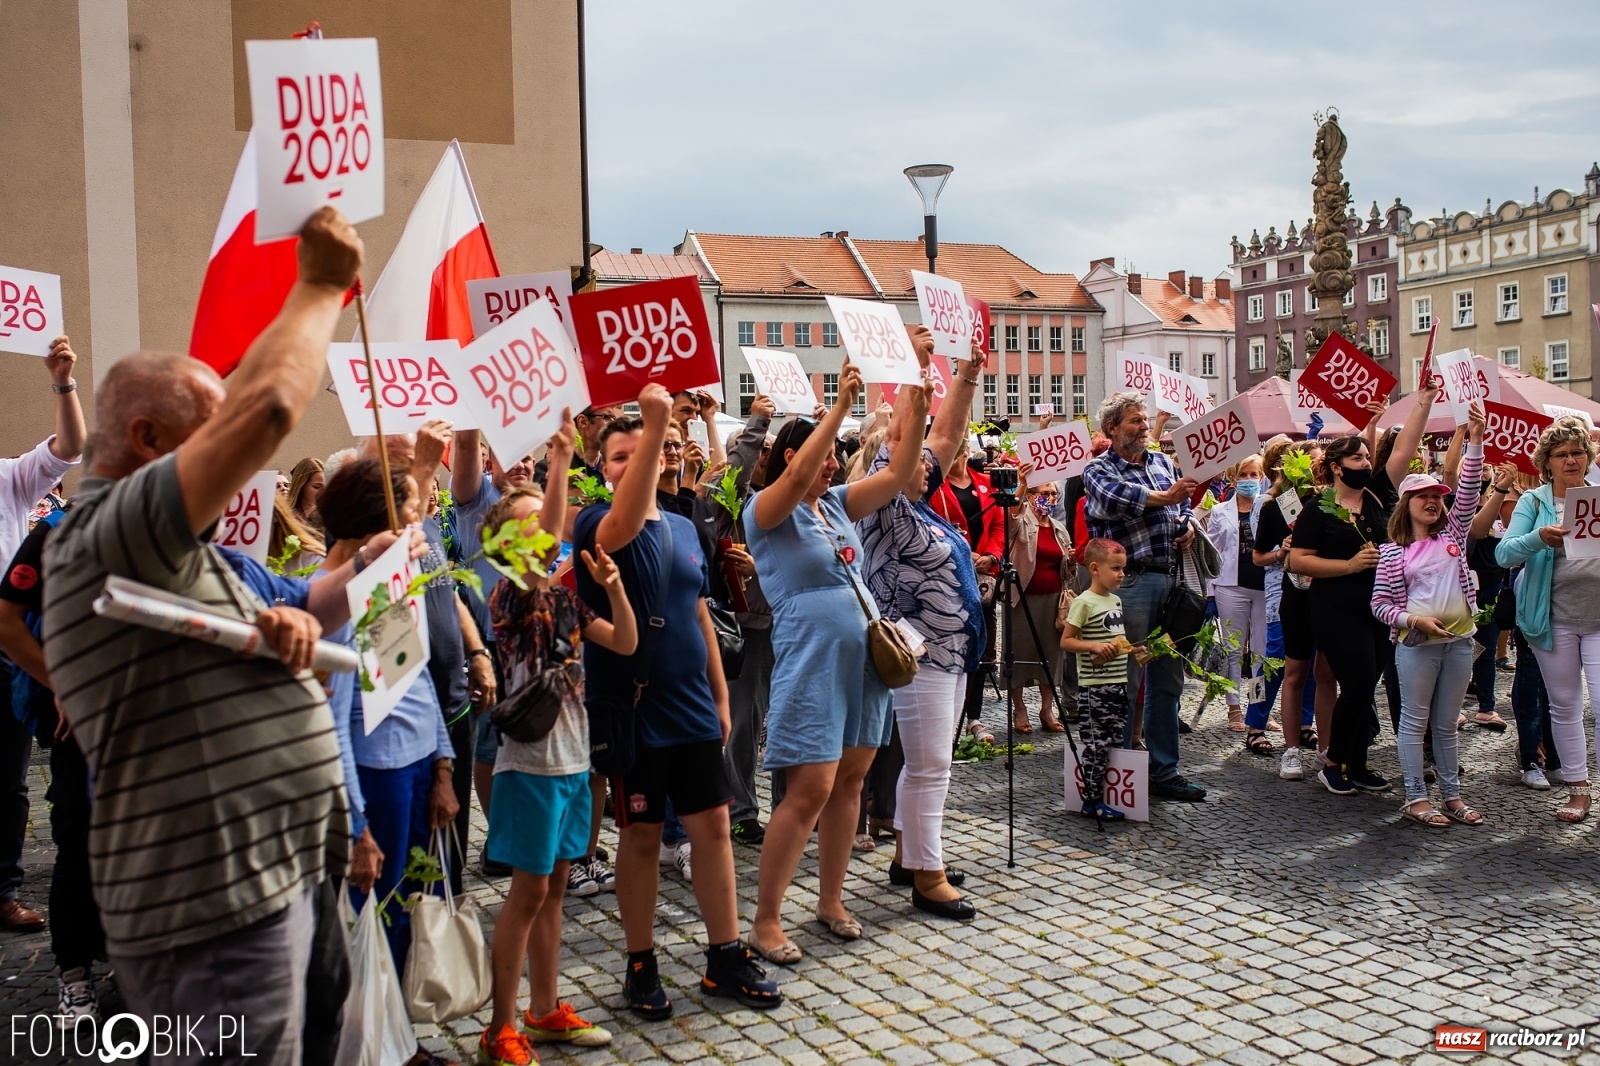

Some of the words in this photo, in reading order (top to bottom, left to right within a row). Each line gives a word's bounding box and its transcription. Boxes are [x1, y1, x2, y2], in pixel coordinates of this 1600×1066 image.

[276, 72, 368, 130] DUDA
[283, 123, 371, 184] 2020
[1, 280, 44, 309] DA
[485, 285, 560, 315] DUDA
[922, 285, 963, 315] DUDA
[0, 305, 46, 331] 20
[596, 297, 692, 343] DUDA
[842, 311, 899, 339] DUDA
[930, 309, 966, 337] 2020
[968, 305, 984, 331] DA
[602, 326, 697, 375] 2020
[854, 334, 907, 362] 2020
[348, 357, 451, 384] DUDA
[469, 327, 556, 398] DUDA
[755, 358, 801, 379] DUDA
[1125, 360, 1152, 377] DUD
[1329, 348, 1379, 397] DUDA
[360, 381, 458, 409] 2020
[491, 355, 567, 428] 2020
[764, 375, 807, 397] 2020
[1125, 374, 1154, 391] 202
[1159, 373, 1181, 391] DU
[1162, 387, 1180, 404] 20
[1317, 362, 1372, 409] 2020
[1184, 399, 1198, 421] 20
[1186, 384, 1206, 417] DUD
[1298, 393, 1331, 410] 202
[1185, 411, 1242, 453] DUDA
[1486, 412, 1540, 442] DUDA
[1028, 431, 1081, 457] DUDA
[1191, 426, 1246, 469] 2020
[1483, 429, 1538, 458] 2020
[1033, 445, 1084, 471] 2020
[224, 488, 260, 517] DA
[1575, 498, 1600, 519] DU
[222, 517, 260, 546] 20
[1574, 518, 1600, 539] 20
